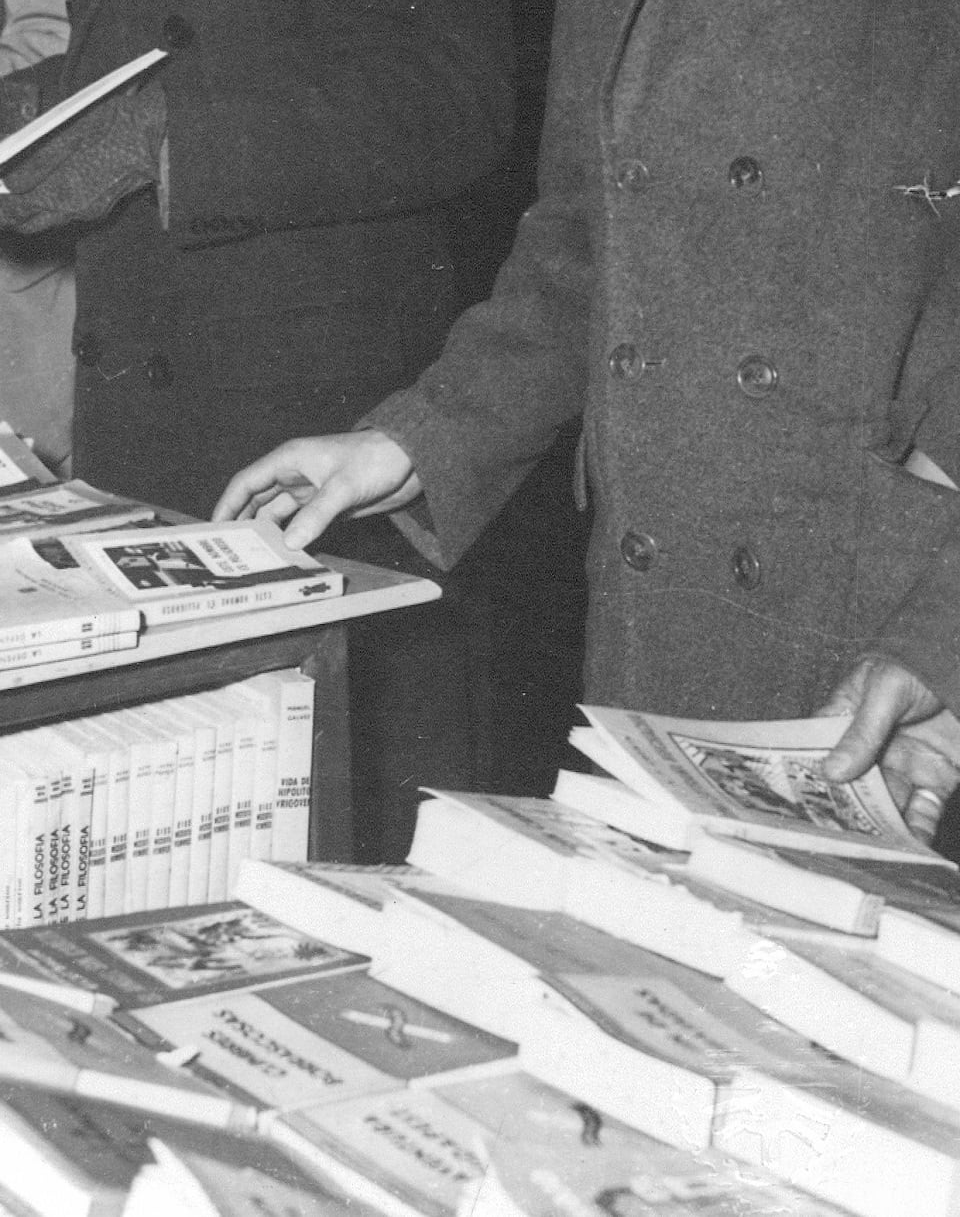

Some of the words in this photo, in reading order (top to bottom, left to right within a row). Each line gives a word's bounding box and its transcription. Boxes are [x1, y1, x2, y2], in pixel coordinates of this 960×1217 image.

[34, 833, 45, 896] FILOSOFIA
[48, 829, 59, 891] FILOSOFIA
[60, 824, 71, 886] FILOSOFIA
[77, 825, 89, 887] FILOSOFIA
[32, 902, 43, 919] LA
[48, 897, 57, 915] LA
[59, 894, 69, 910] LA
[76, 894, 86, 911] LA
